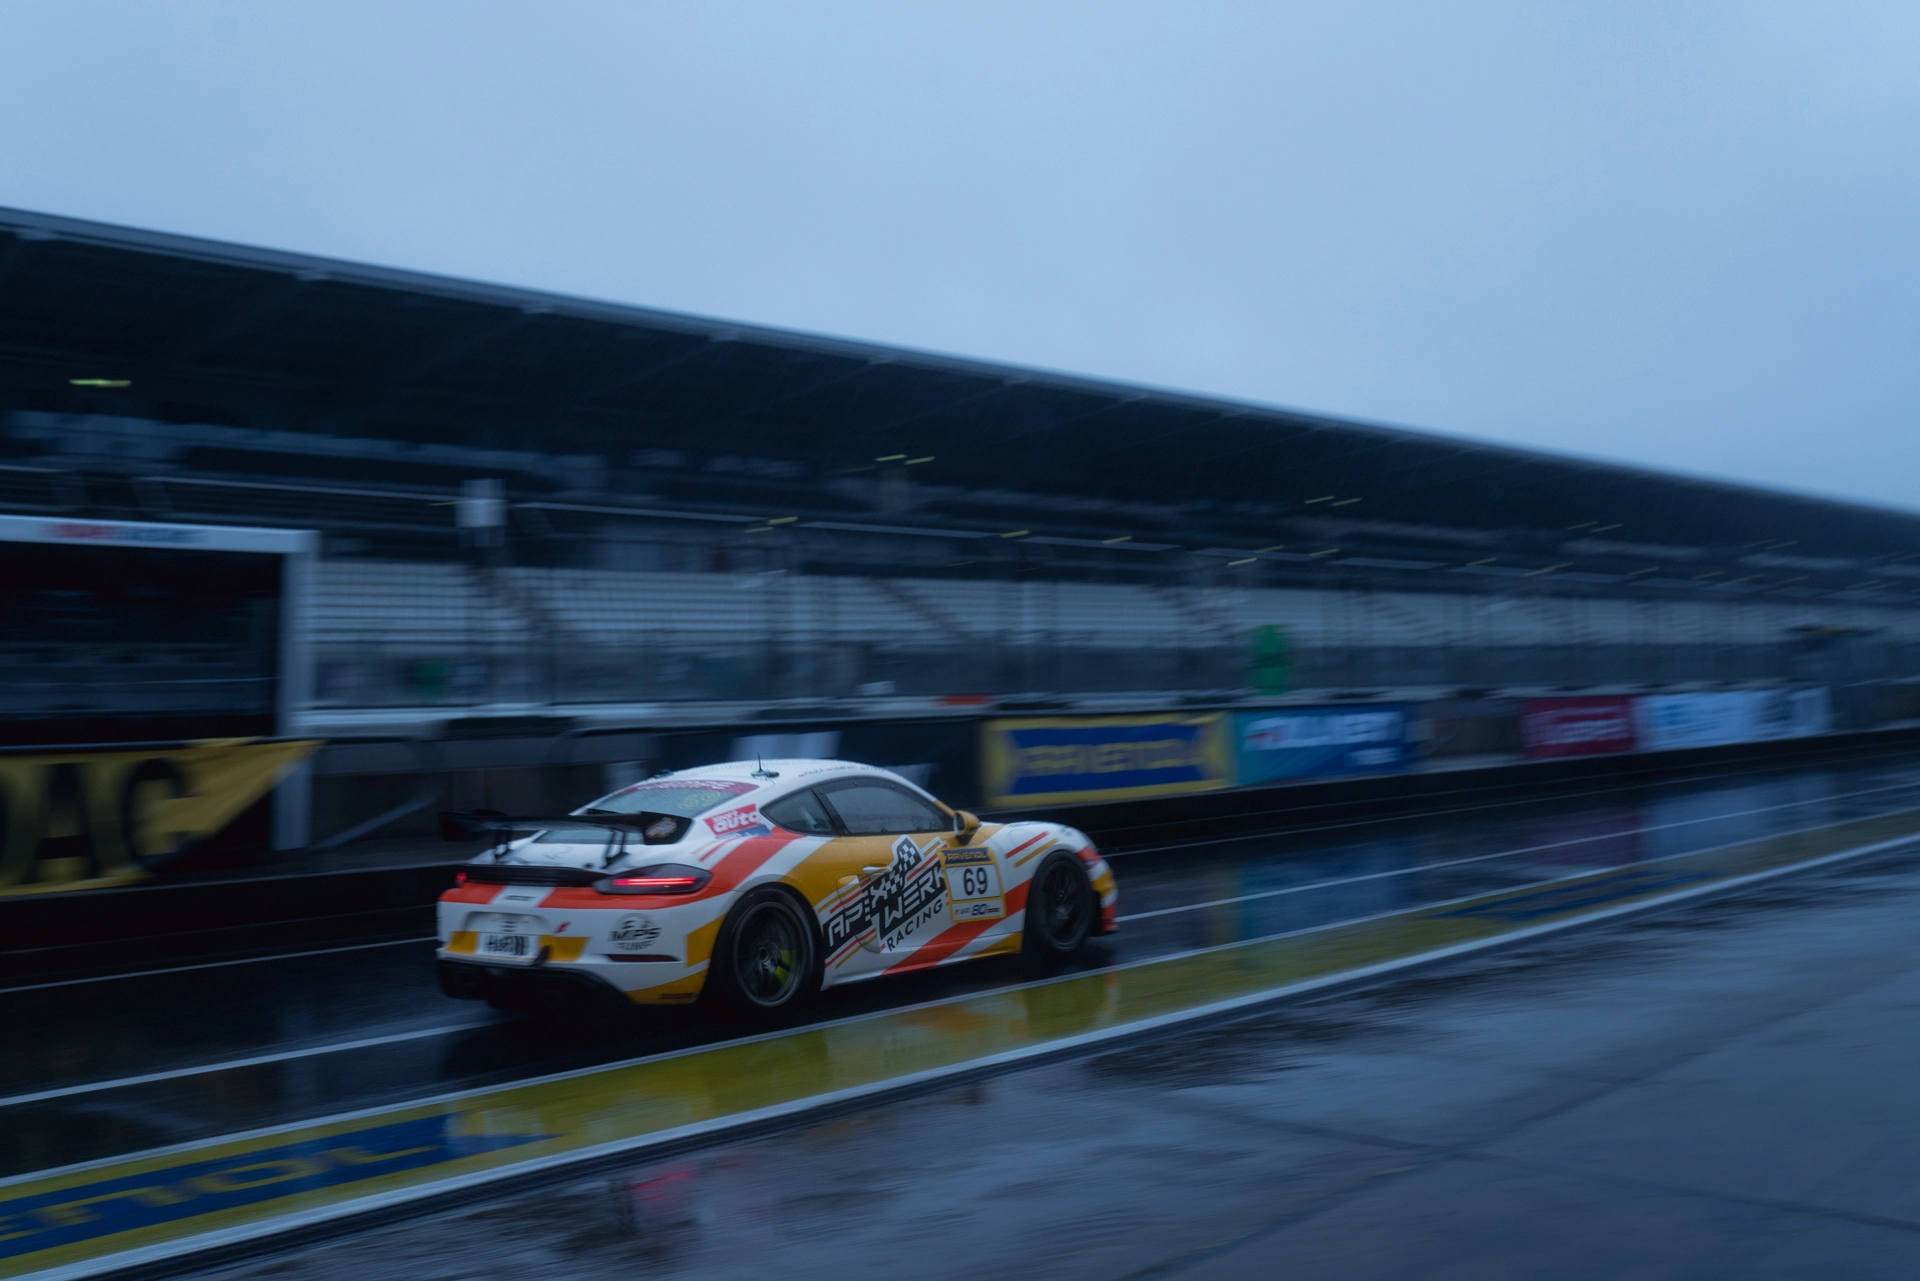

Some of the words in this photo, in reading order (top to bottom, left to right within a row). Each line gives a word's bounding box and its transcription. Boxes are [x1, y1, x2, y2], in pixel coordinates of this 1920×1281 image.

[713, 811, 760, 833] auto
[946, 851, 988, 861] RAVENOL
[963, 866, 989, 896] 69
[886, 899, 944, 952] RACING
